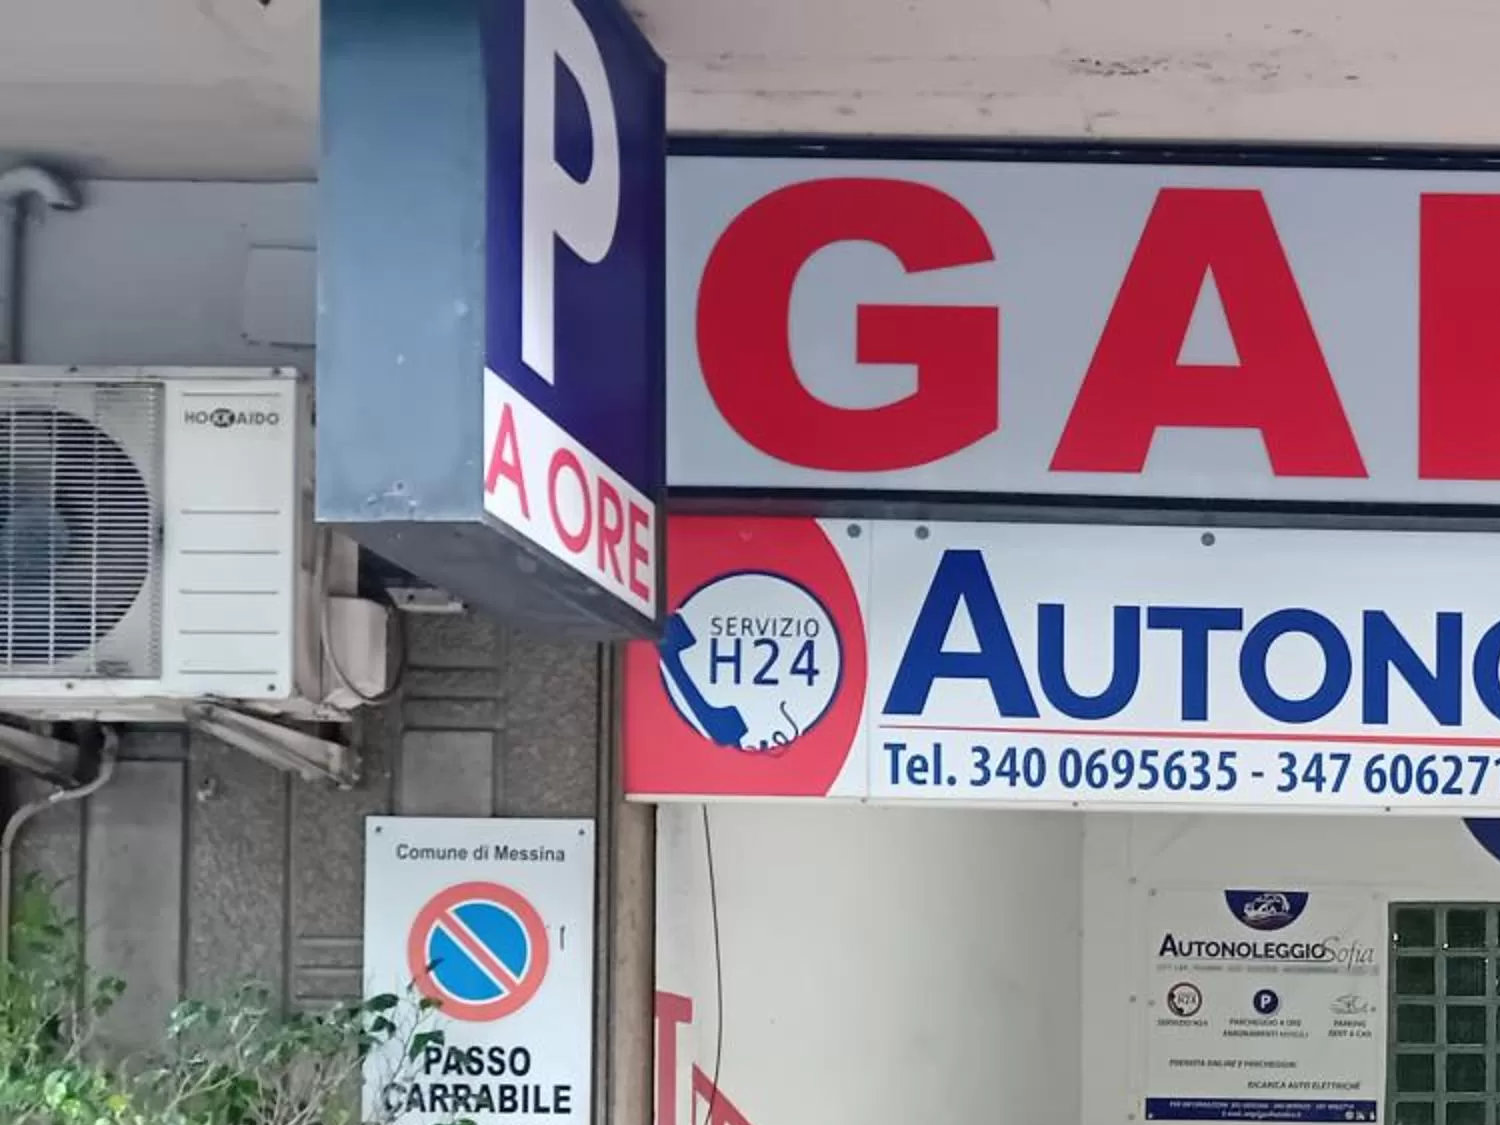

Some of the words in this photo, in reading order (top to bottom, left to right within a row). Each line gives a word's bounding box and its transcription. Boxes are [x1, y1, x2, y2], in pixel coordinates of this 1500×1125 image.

[521, 0, 620, 387] P
[484, 402, 531, 521] A
[547, 447, 650, 603] ORE
[710, 616, 820, 638] SERVIZIO
[709, 637, 820, 687] H24
[883, 742, 956, 786] Tel.
[970, 744, 1047, 787] 340
[1058, 748, 1238, 792] 0695635
[1276, 752, 1351, 793] 347
[396, 843, 468, 861] Comune
[473, 844, 489, 861] di
[494, 844, 566, 863] Messina
[1159, 933, 1325, 959] AUTONOLEGGIO
[1260, 994, 1272, 1010] P
[424, 1045, 531, 1077] PASSO
[383, 1082, 572, 1115] CARRABILE
